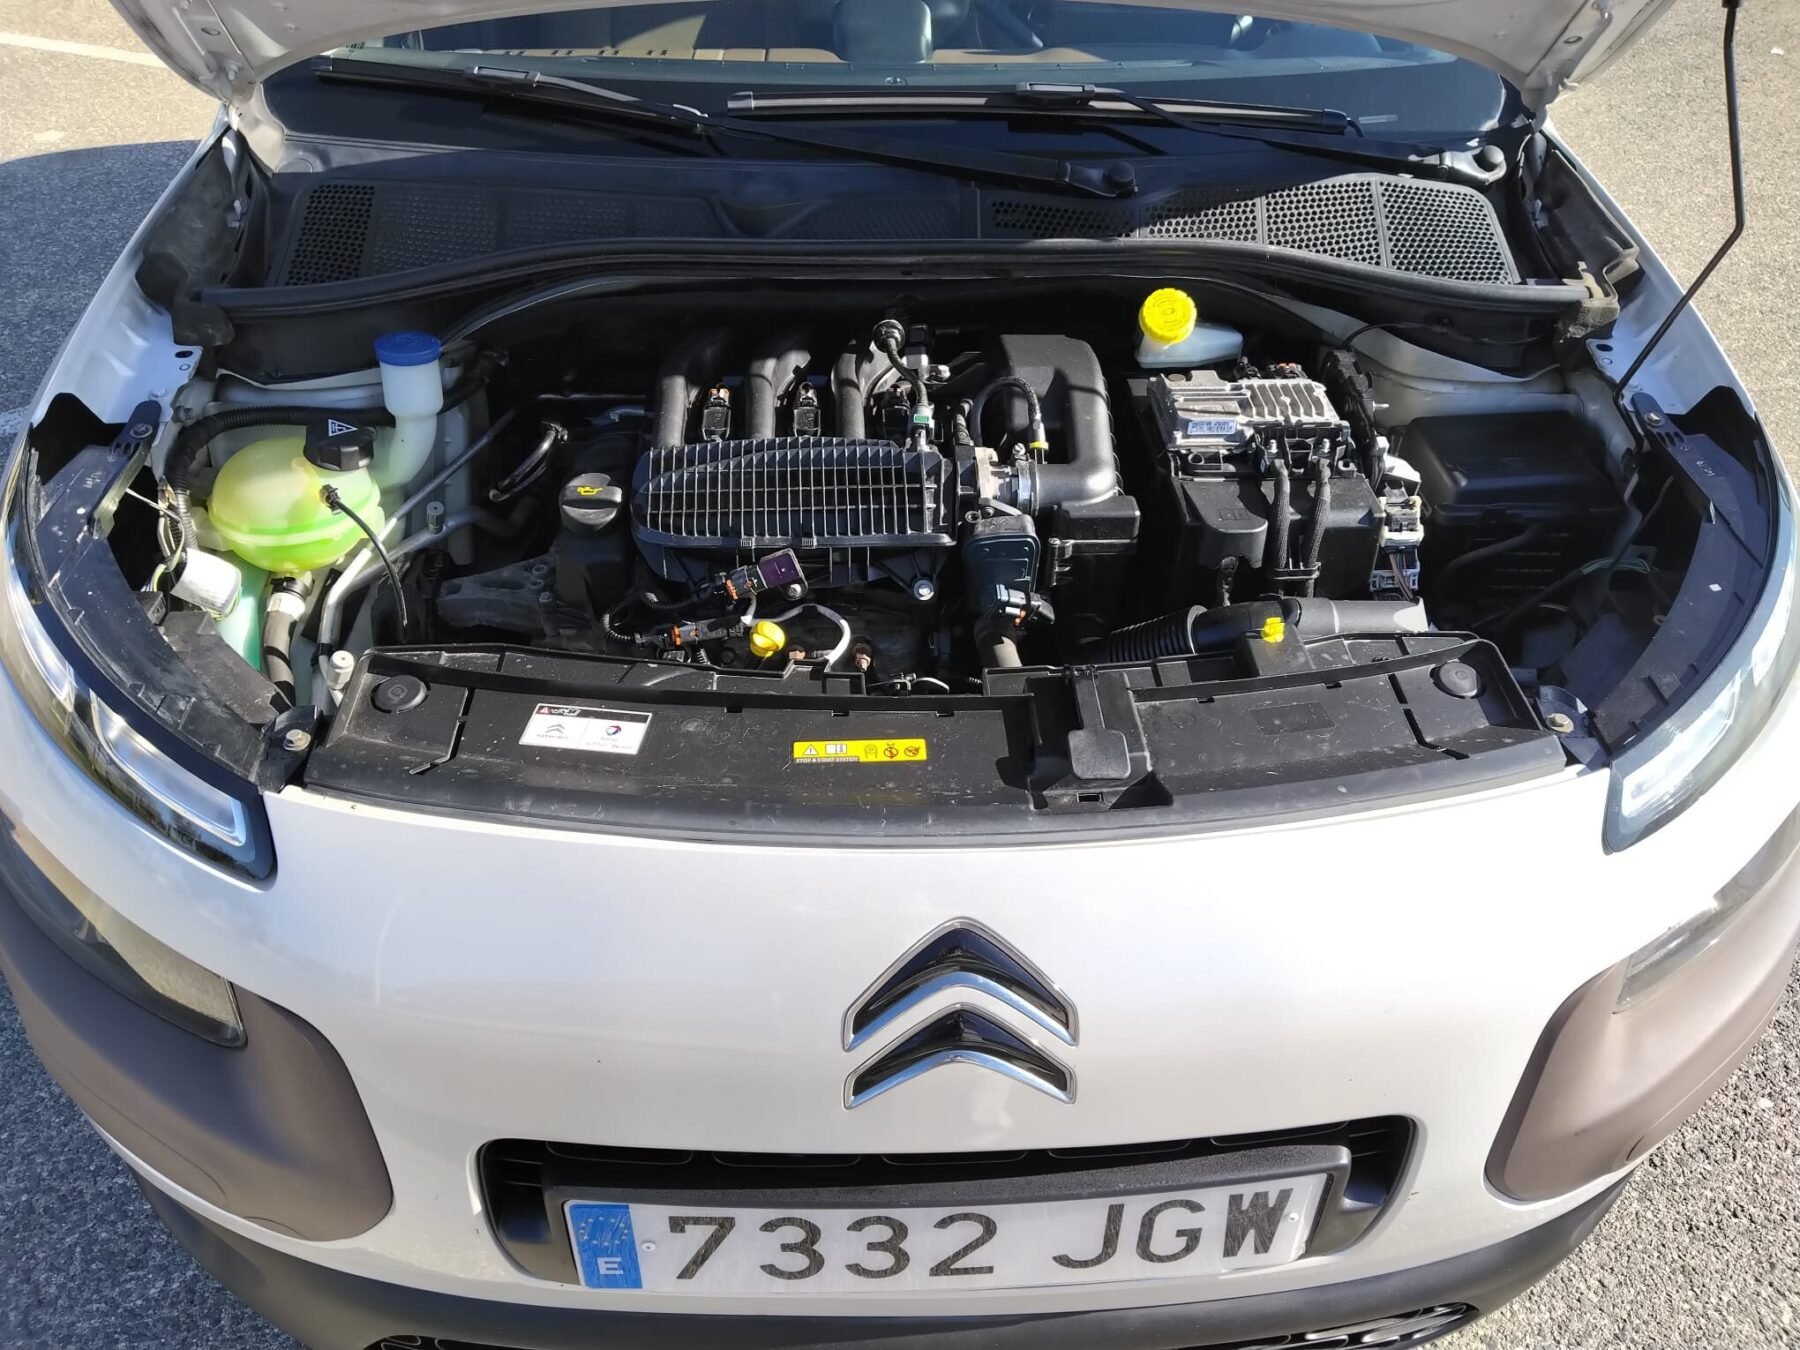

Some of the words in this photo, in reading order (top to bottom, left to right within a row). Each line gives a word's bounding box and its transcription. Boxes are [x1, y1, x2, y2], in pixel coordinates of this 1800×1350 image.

[668, 1212, 998, 1280] 7332
[1052, 1188, 1294, 1269] JGW
[597, 1257, 624, 1275] E
